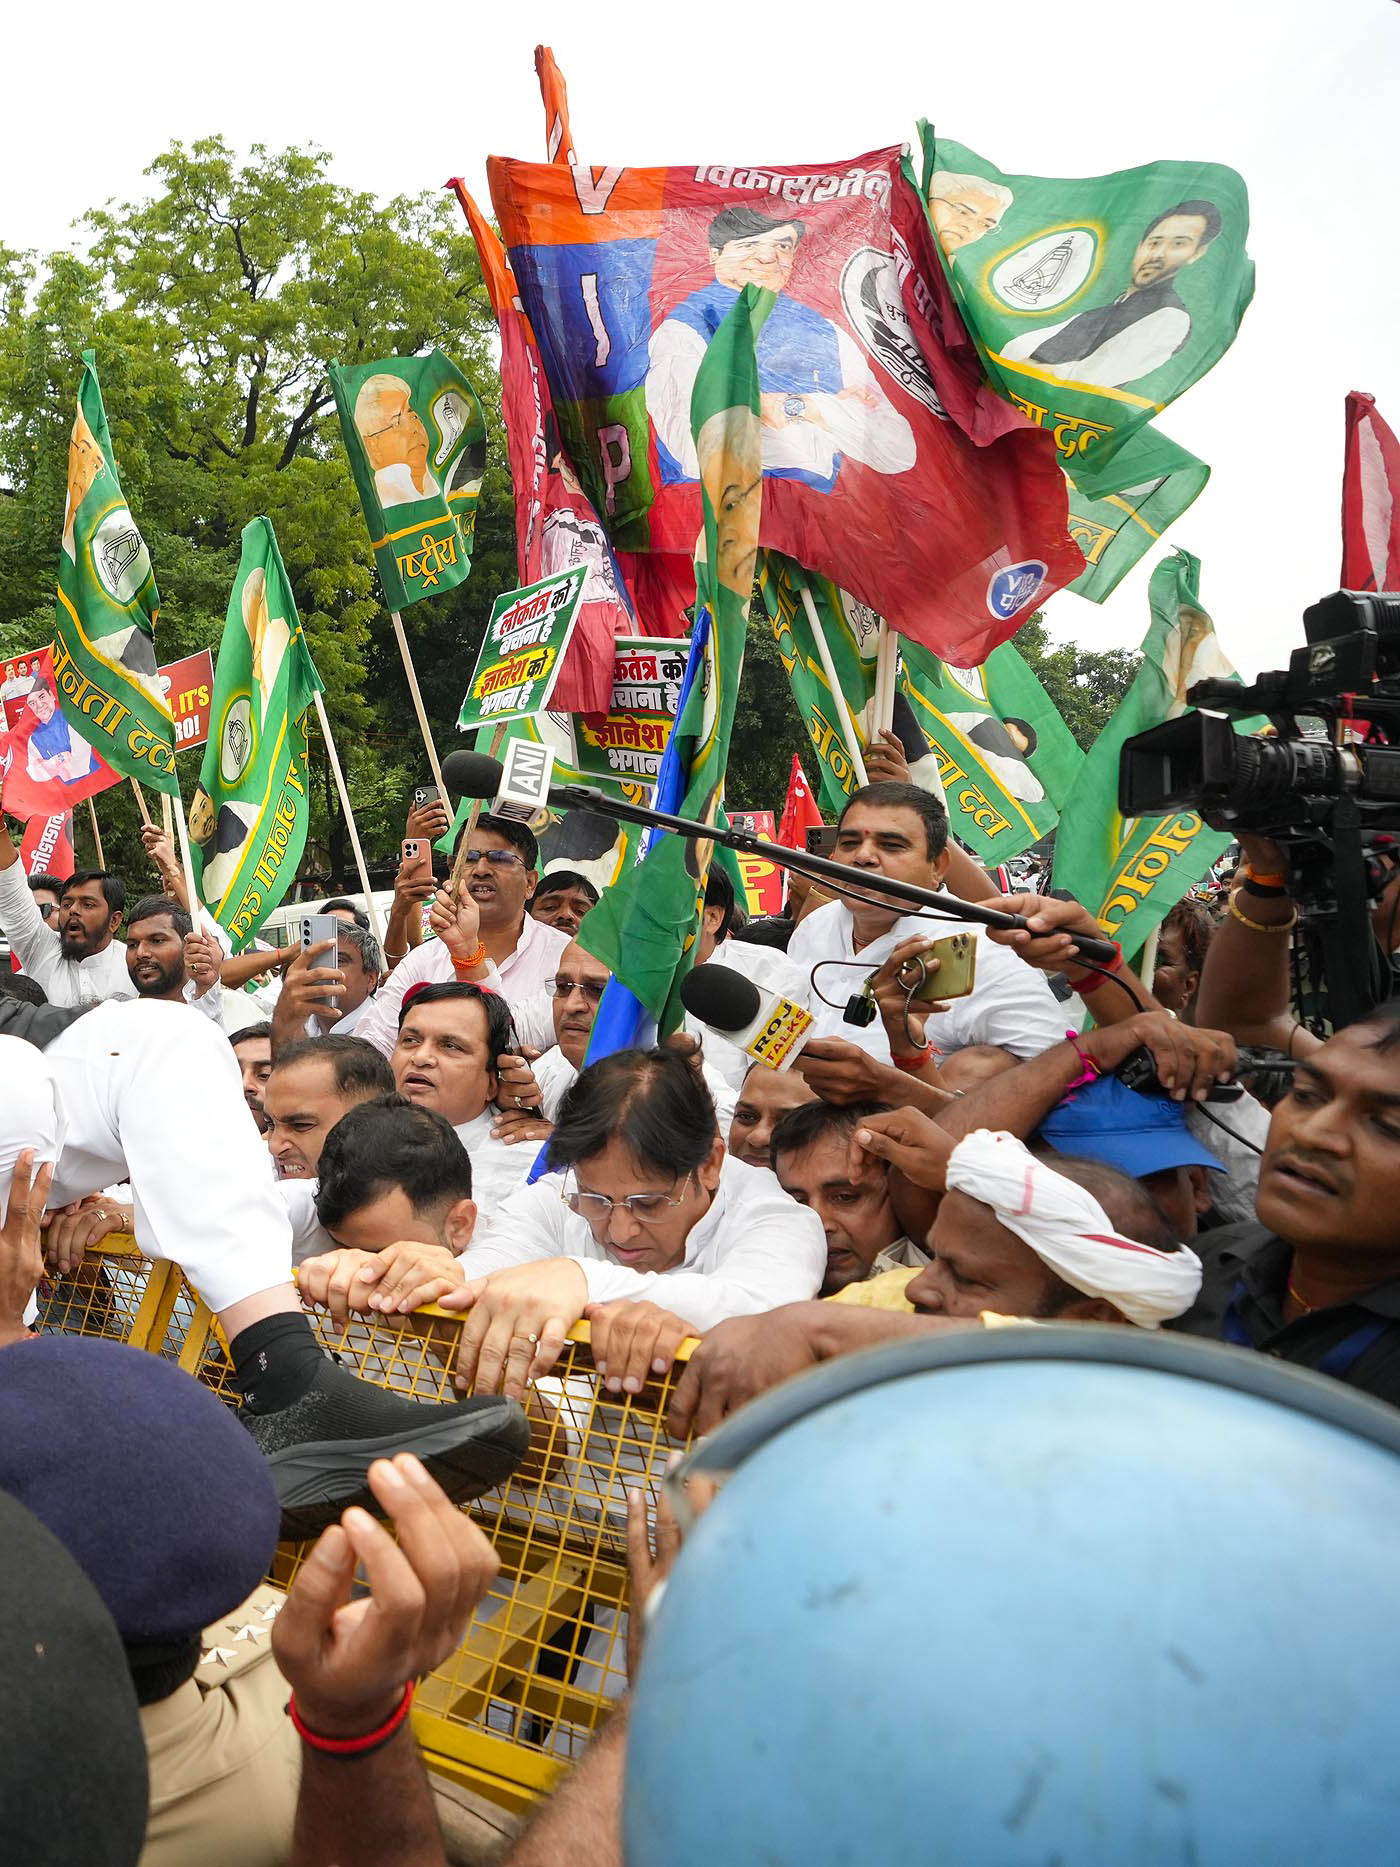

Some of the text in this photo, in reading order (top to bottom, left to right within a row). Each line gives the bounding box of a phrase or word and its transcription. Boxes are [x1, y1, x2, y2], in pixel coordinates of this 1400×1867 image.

[499, 578, 572, 636] लोकतंत्र को
[499, 611, 556, 656] बचाना है
[480, 649, 549, 697] ज्ञानेश को
[613, 650, 658, 682] कतंत्र
[52, 630, 177, 775] जनता दल
[178, 684, 210, 715] IT'S
[479, 677, 535, 717] भगाना है
[609, 686, 662, 711] चाना
[175, 713, 200, 743] RO!
[511, 746, 544, 795] ANI
[608, 748, 664, 774] भगान
[958, 782, 1013, 839] दल
